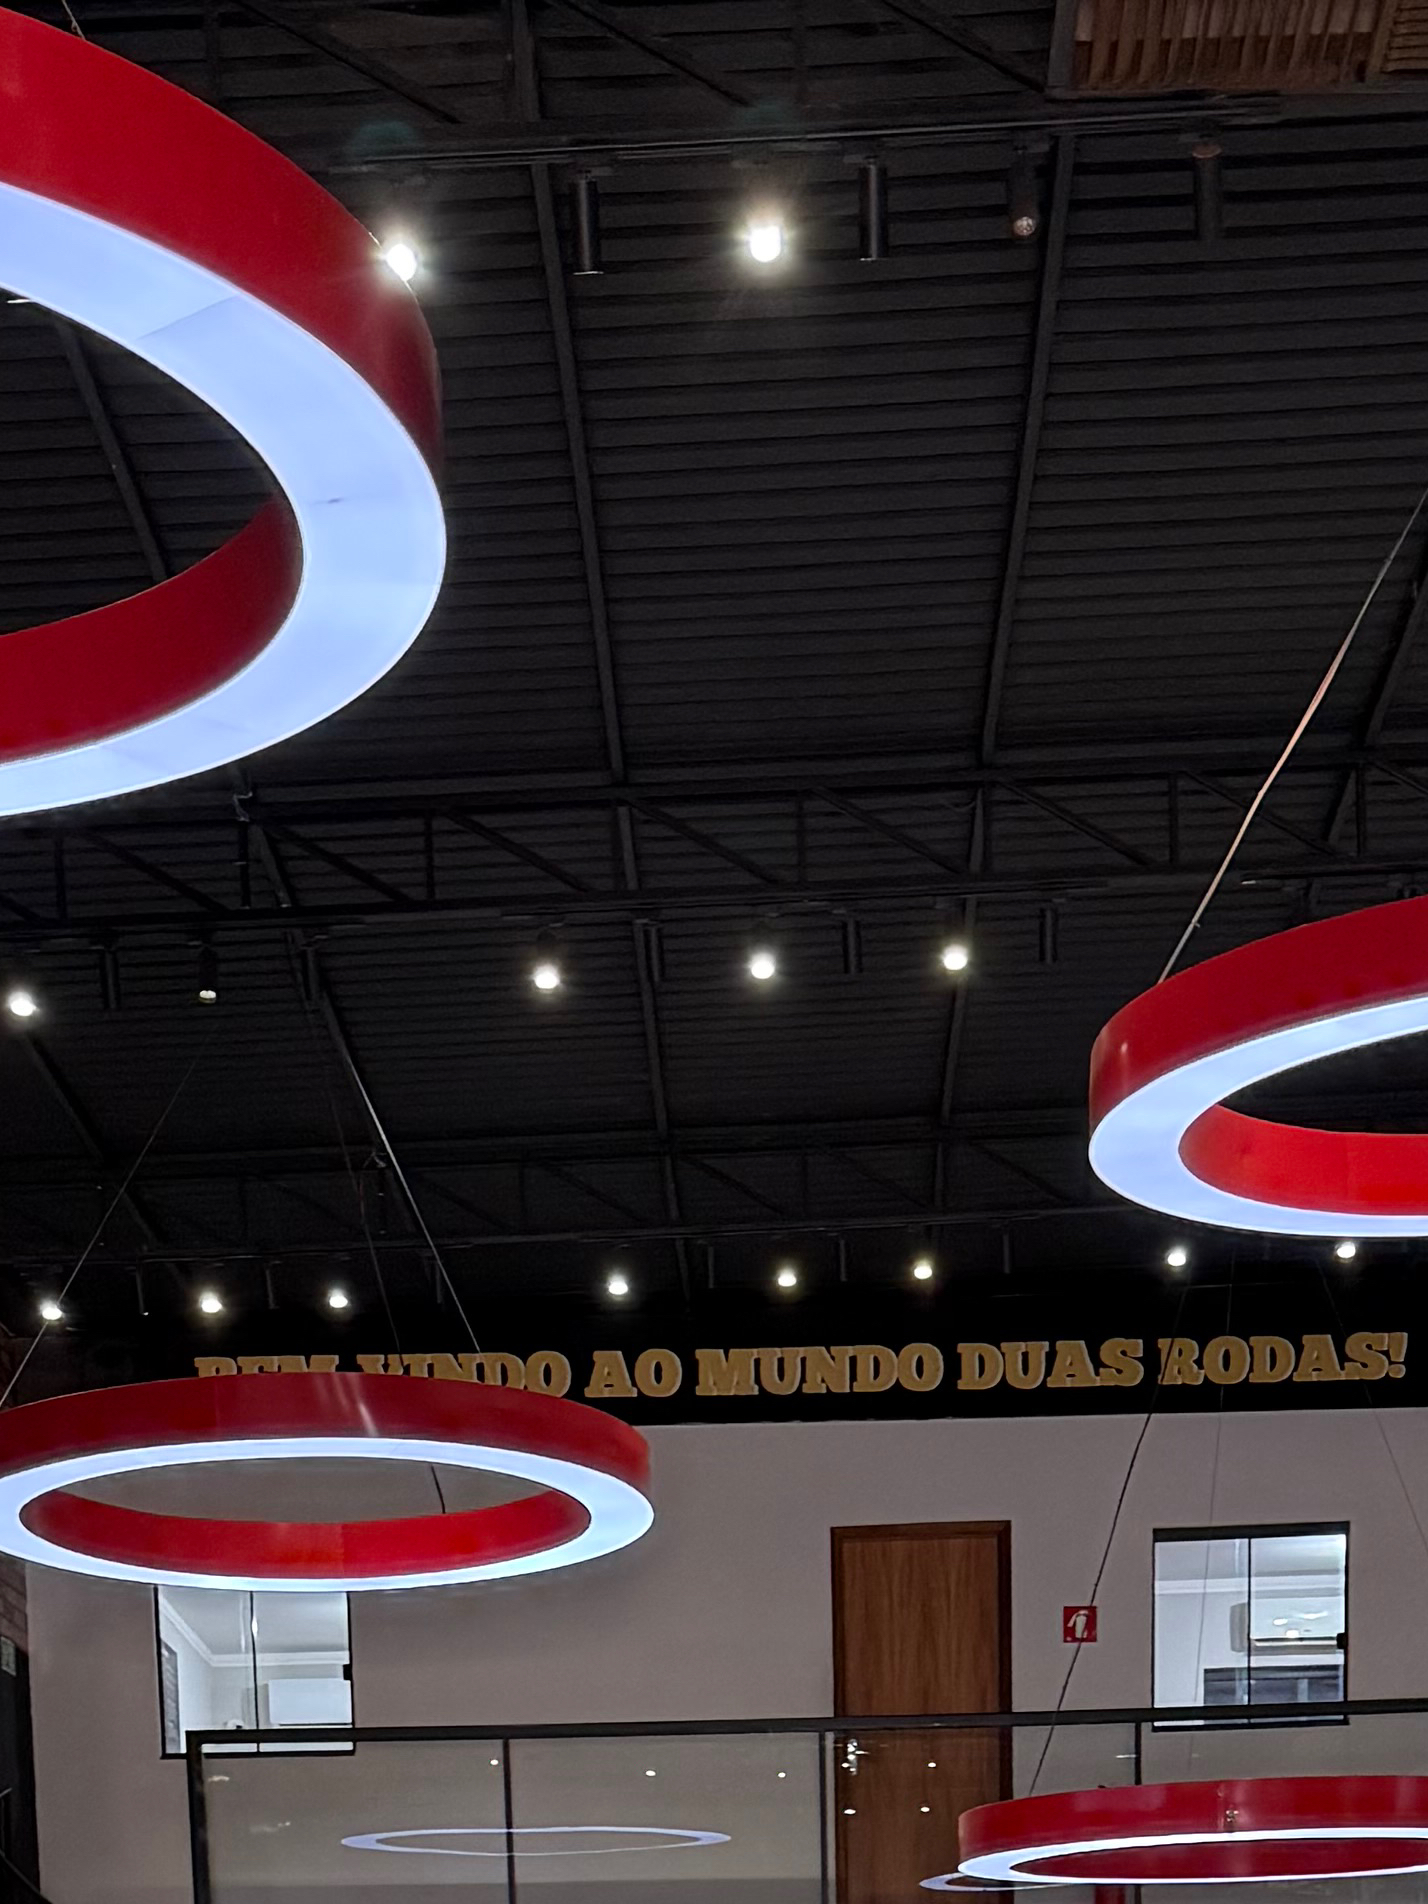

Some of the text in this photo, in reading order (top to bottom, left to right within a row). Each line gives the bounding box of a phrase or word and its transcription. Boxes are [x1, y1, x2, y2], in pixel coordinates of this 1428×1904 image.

[585, 1348, 682, 1398] AO
[695, 1343, 944, 1396] MUNDO
[957, 1338, 1143, 1390] DUAS
[1158, 1332, 1408, 1385] RODAS!
